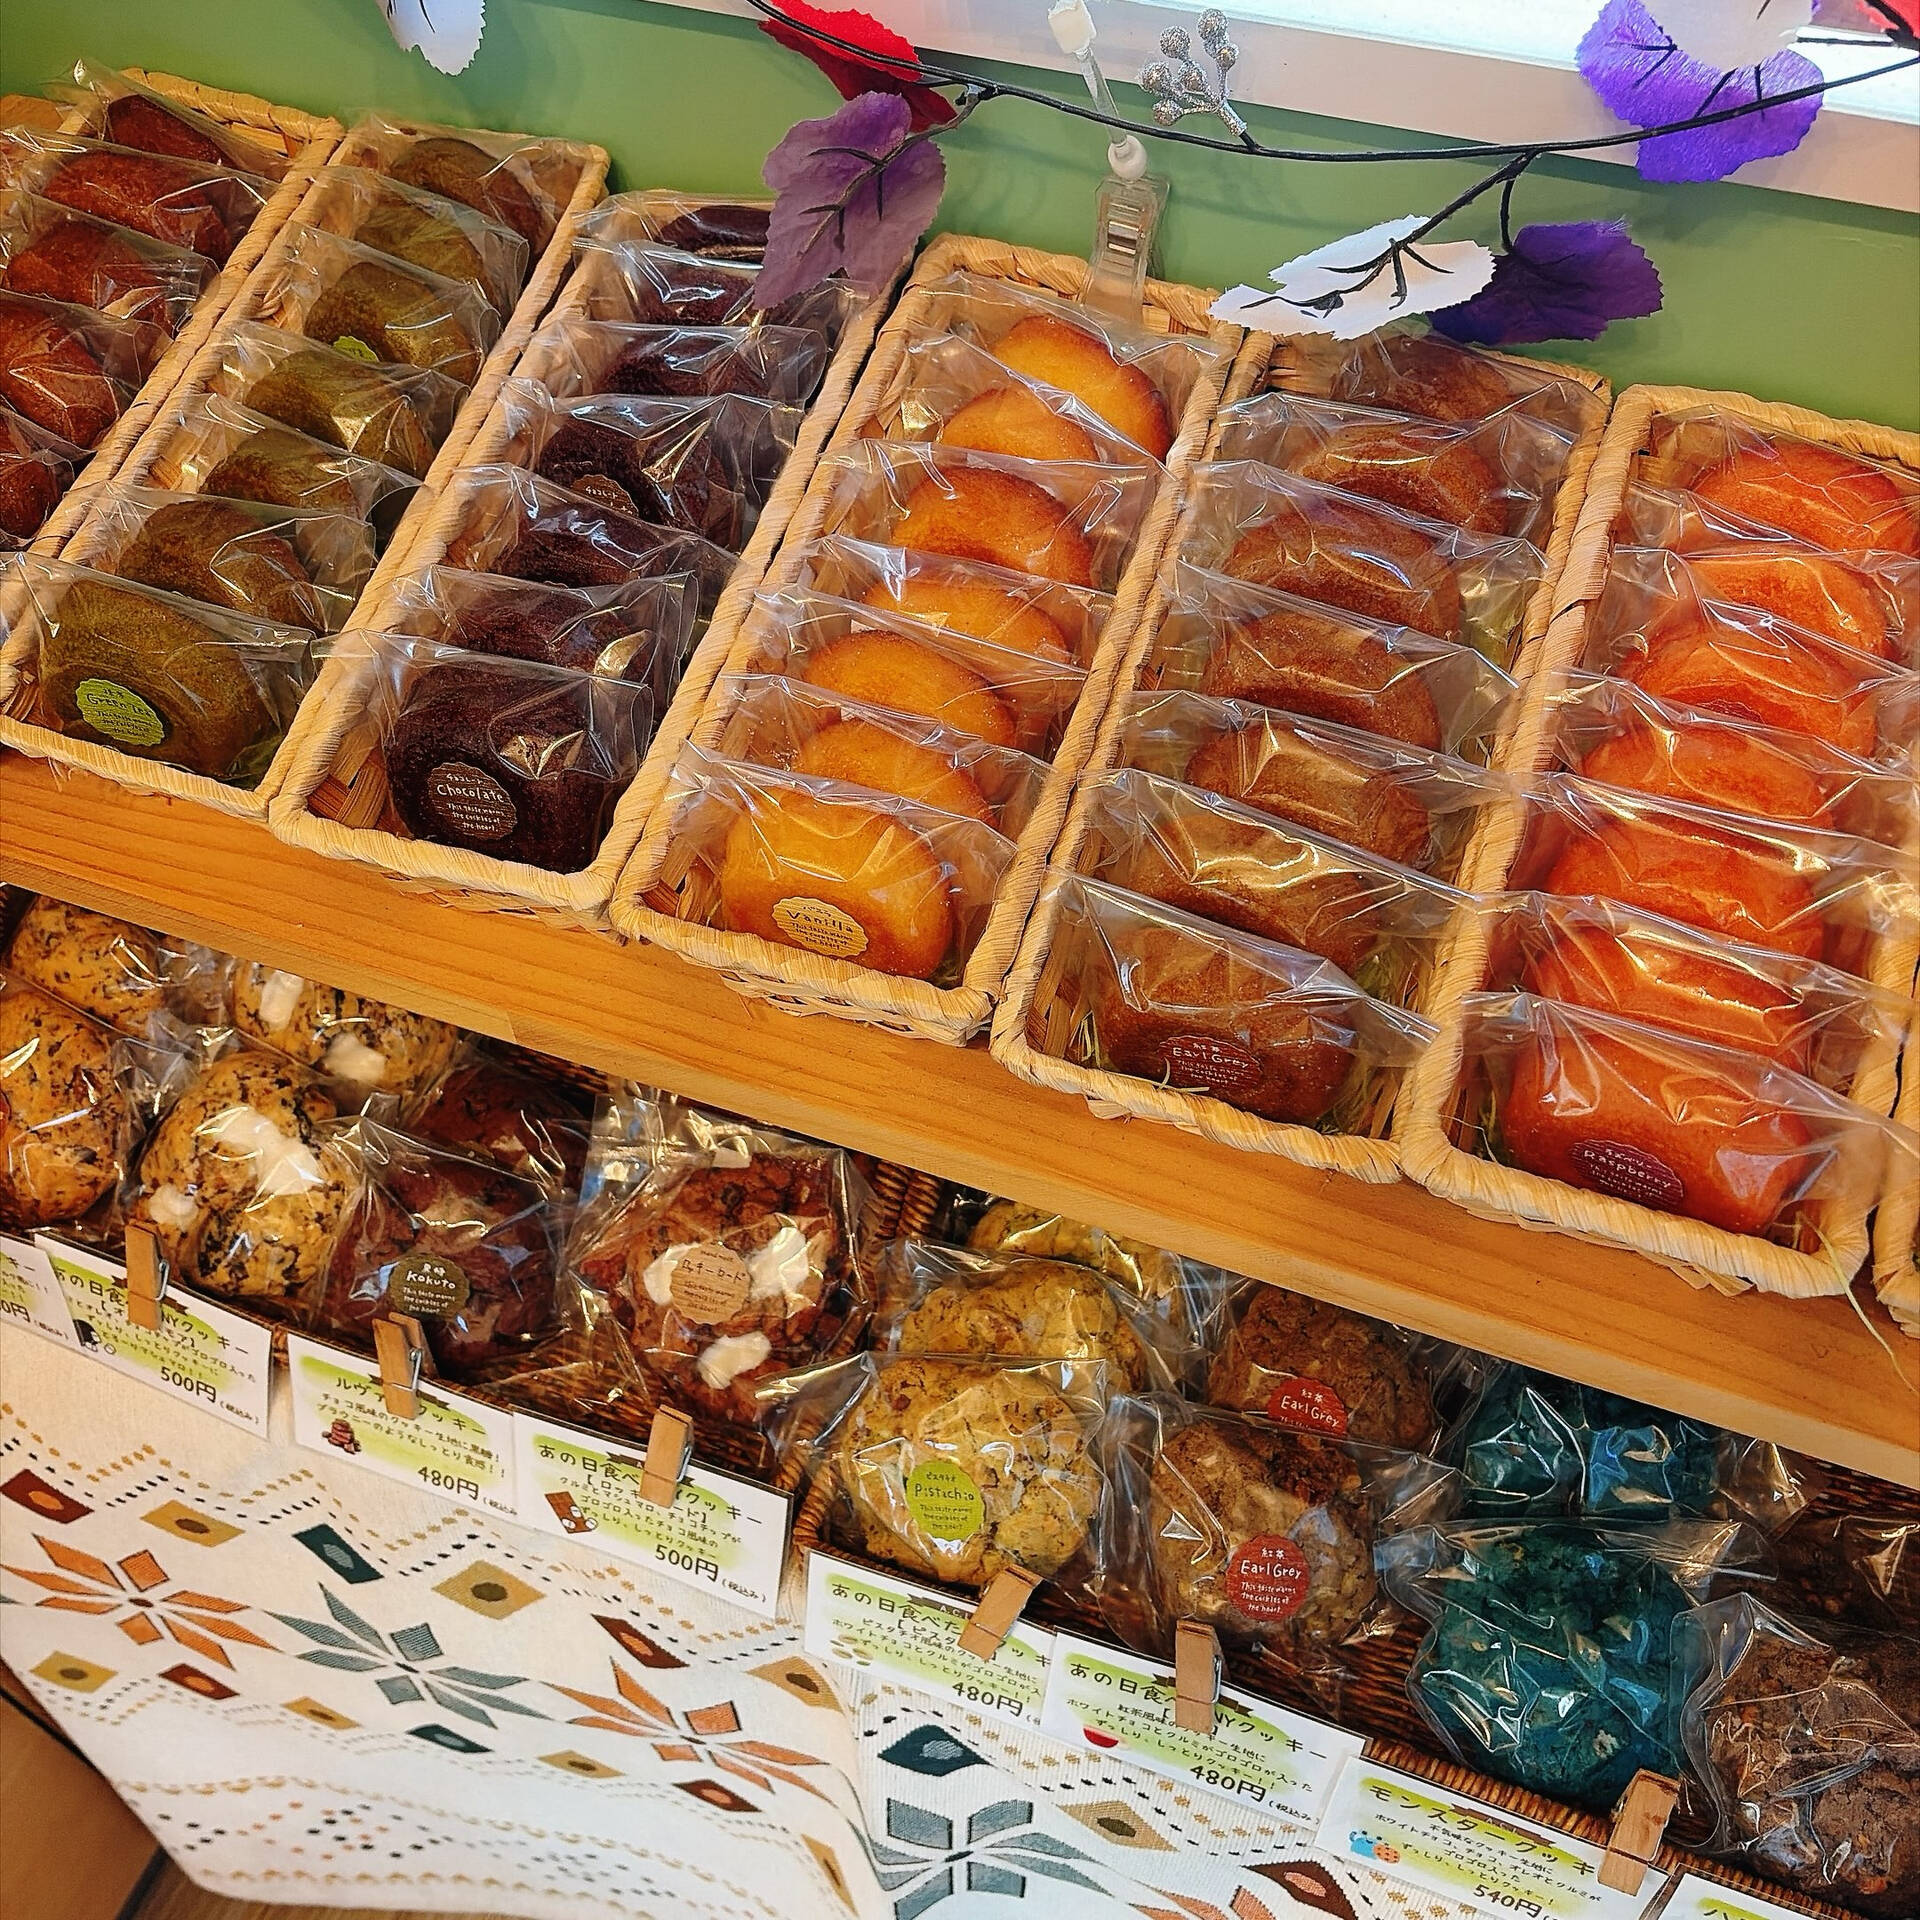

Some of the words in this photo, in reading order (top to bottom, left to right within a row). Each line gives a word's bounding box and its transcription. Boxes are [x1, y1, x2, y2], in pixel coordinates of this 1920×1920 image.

[86, 693, 128, 710] Green
[436, 783, 505, 803] Chocolate
[786, 909, 854, 933] Vanilla
[1172, 1046, 1207, 1060] Earl
[1211, 1053, 1249, 1069] Grey
[1583, 1149, 1672, 1189] Raspberry
[682, 1258, 747, 1284] ロッキーロード
[160, 1366, 217, 1403] 500円
[336, 1376, 487, 1434] ルヴァクッキー
[1280, 1395, 1309, 1414] Earl
[1310, 1406, 1340, 1428] Grey
[417, 1465, 480, 1501] 480円
[586, 1474, 708, 1524] 【ロッキード】
[914, 1482, 975, 1501] Pistachio
[655, 1544, 719, 1582] 500円
[1240, 1559, 1271, 1576] Earl
[1272, 1563, 1302, 1580] Grey
[1261, 1546, 1285, 1560] 紅茶
[951, 1682, 1023, 1717] 480円
[1190, 1765, 1267, 1803] 480円
[1444, 1848, 1521, 1883] ゴロゴロ入った
[1472, 1883, 1543, 1919] 540円
